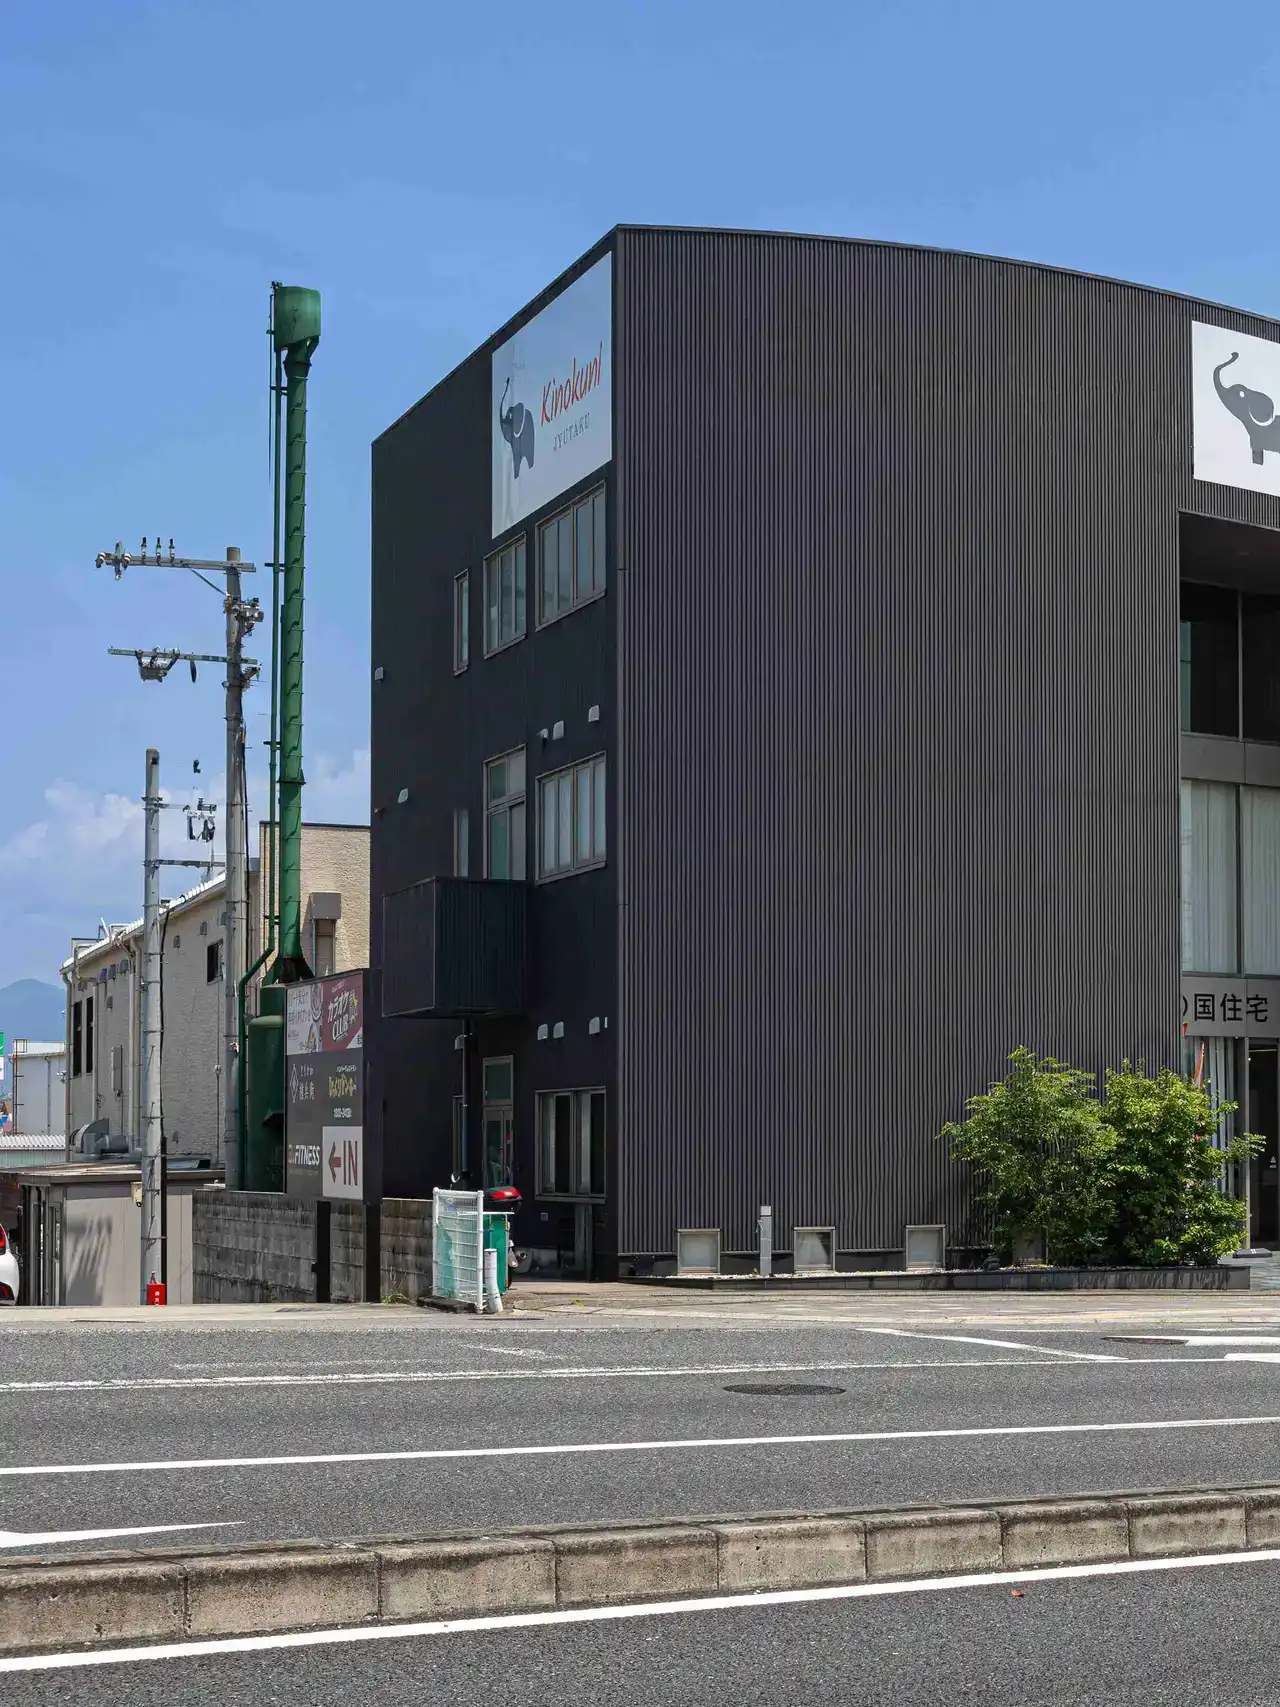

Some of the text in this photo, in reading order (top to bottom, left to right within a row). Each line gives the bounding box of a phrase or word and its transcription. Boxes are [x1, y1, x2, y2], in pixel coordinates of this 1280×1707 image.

[540, 341, 603, 427] Kinokuni
[552, 412, 591, 452] JYUTAKU
[343, 1140, 359, 1187] IN
